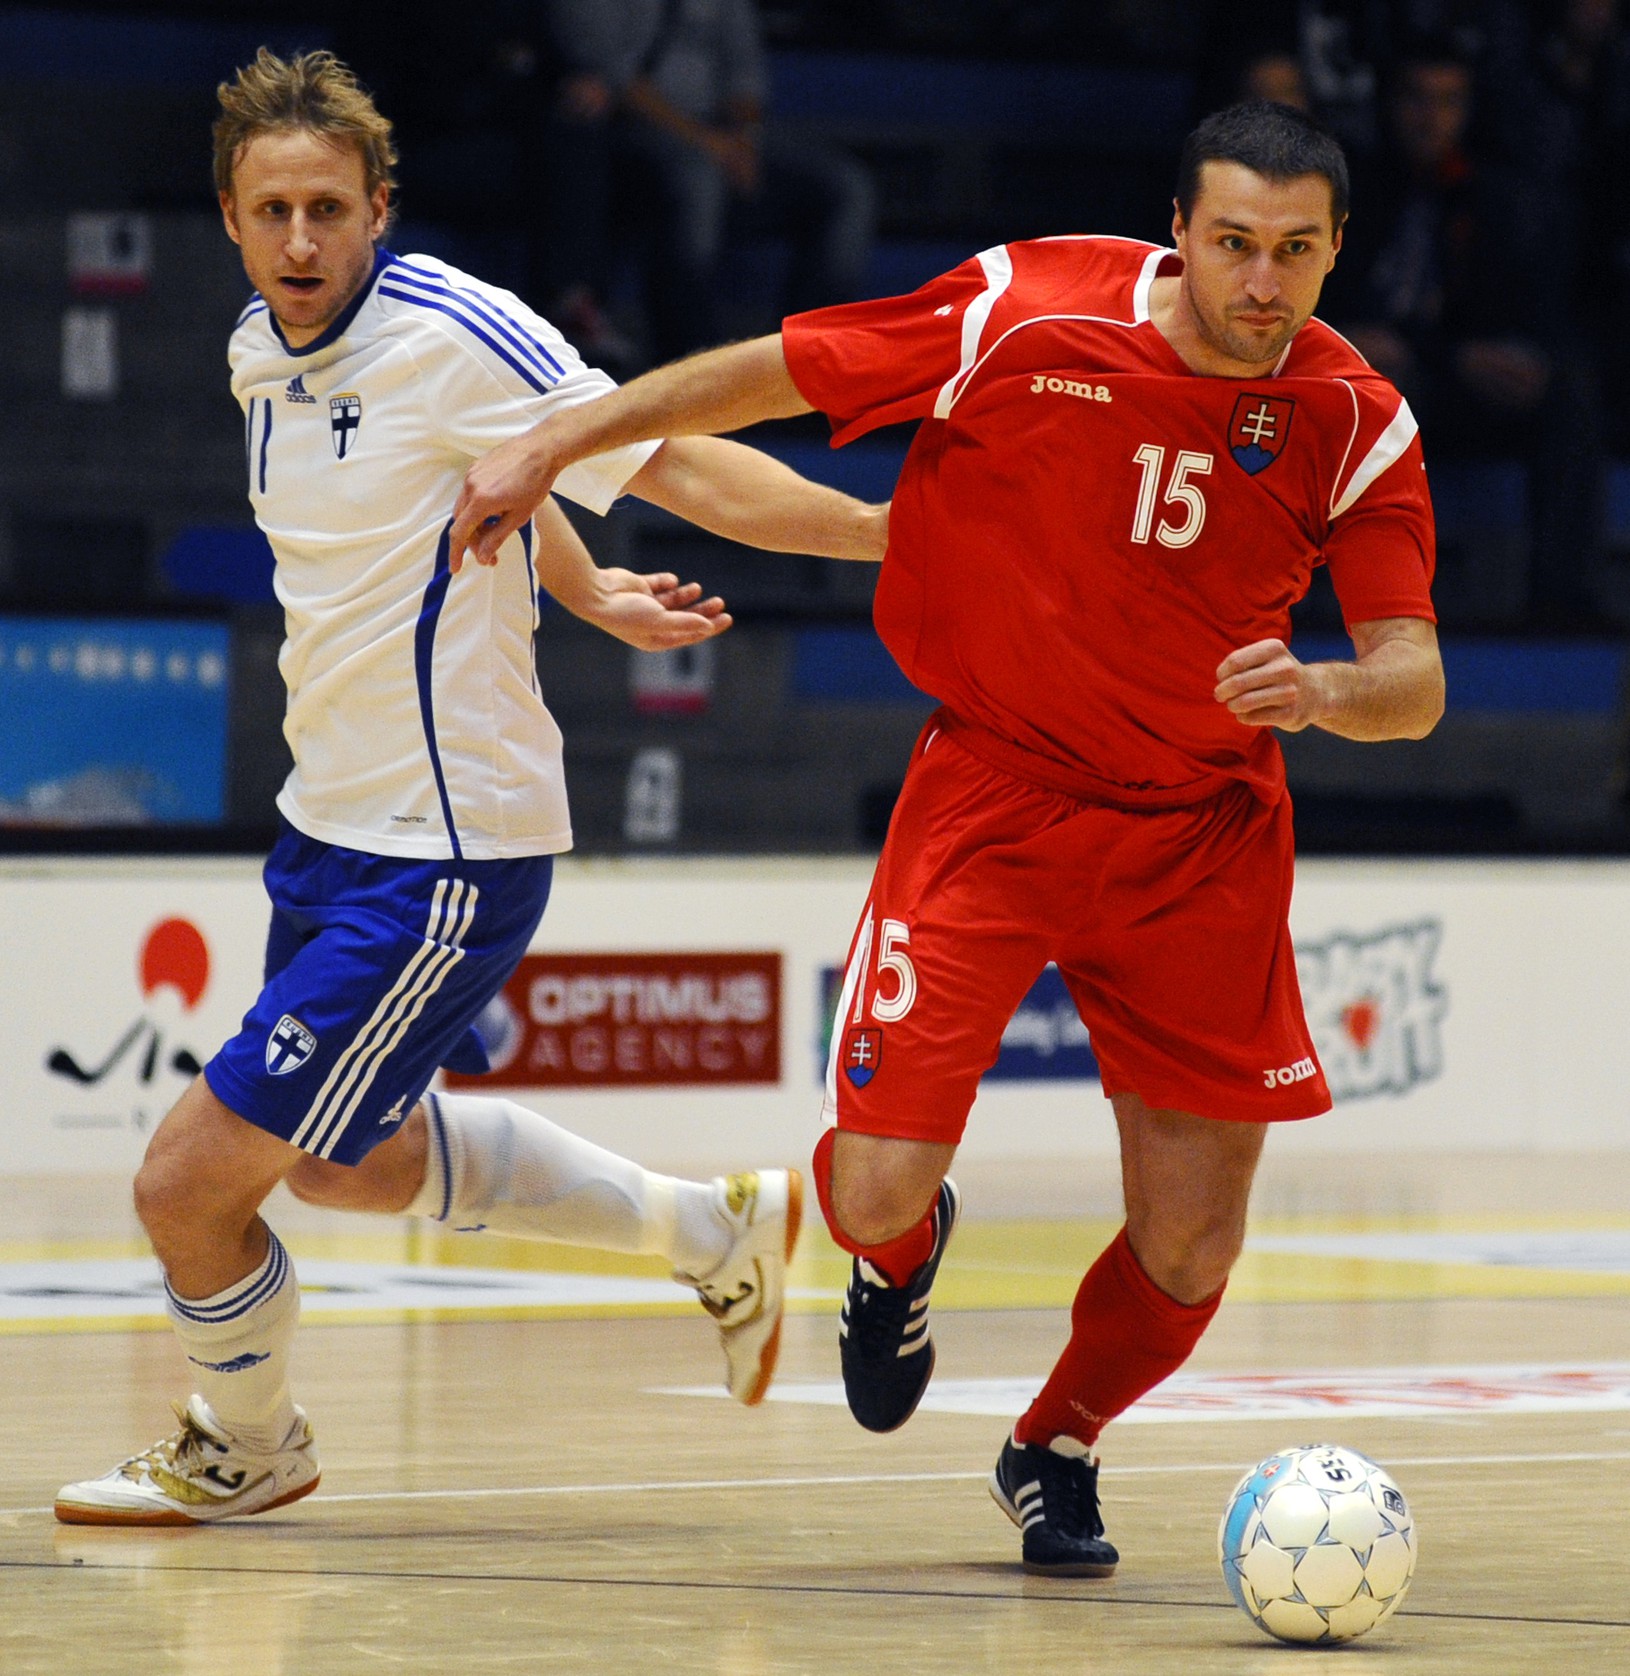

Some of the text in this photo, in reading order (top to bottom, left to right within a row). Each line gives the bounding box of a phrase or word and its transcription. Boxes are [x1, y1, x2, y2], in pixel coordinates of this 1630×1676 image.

[1130, 443, 1214, 549] 15
[528, 974, 769, 1025] OPTIMUS
[853, 918, 917, 1024] 15
[530, 1026, 770, 1072] AGENCY
